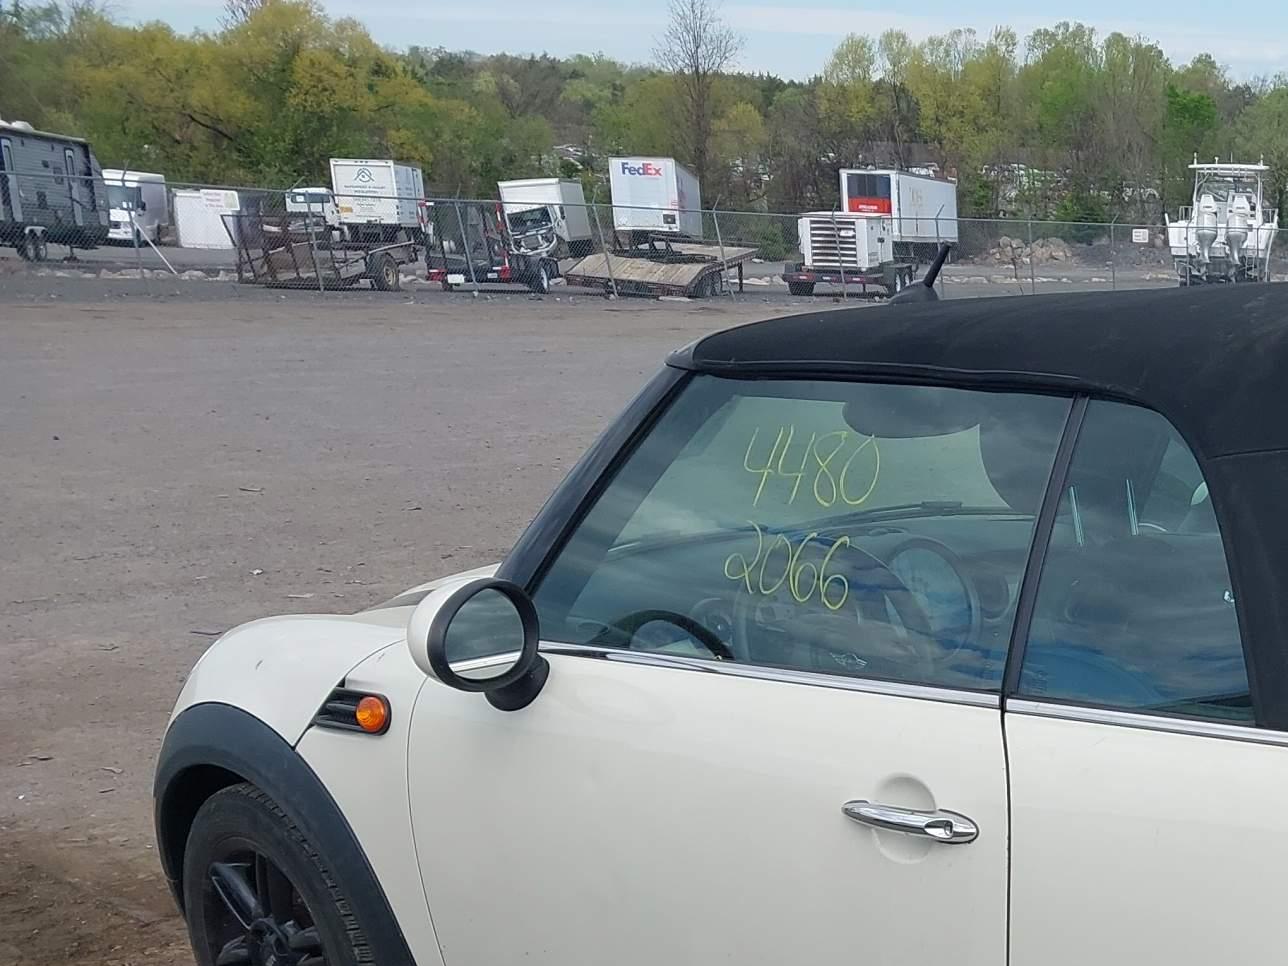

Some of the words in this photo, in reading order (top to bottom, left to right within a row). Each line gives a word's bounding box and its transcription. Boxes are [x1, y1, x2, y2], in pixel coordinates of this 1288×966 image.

[621, 162, 662, 176] FedEx
[743, 424, 880, 507] 4480
[724, 519, 850, 611] 2066
